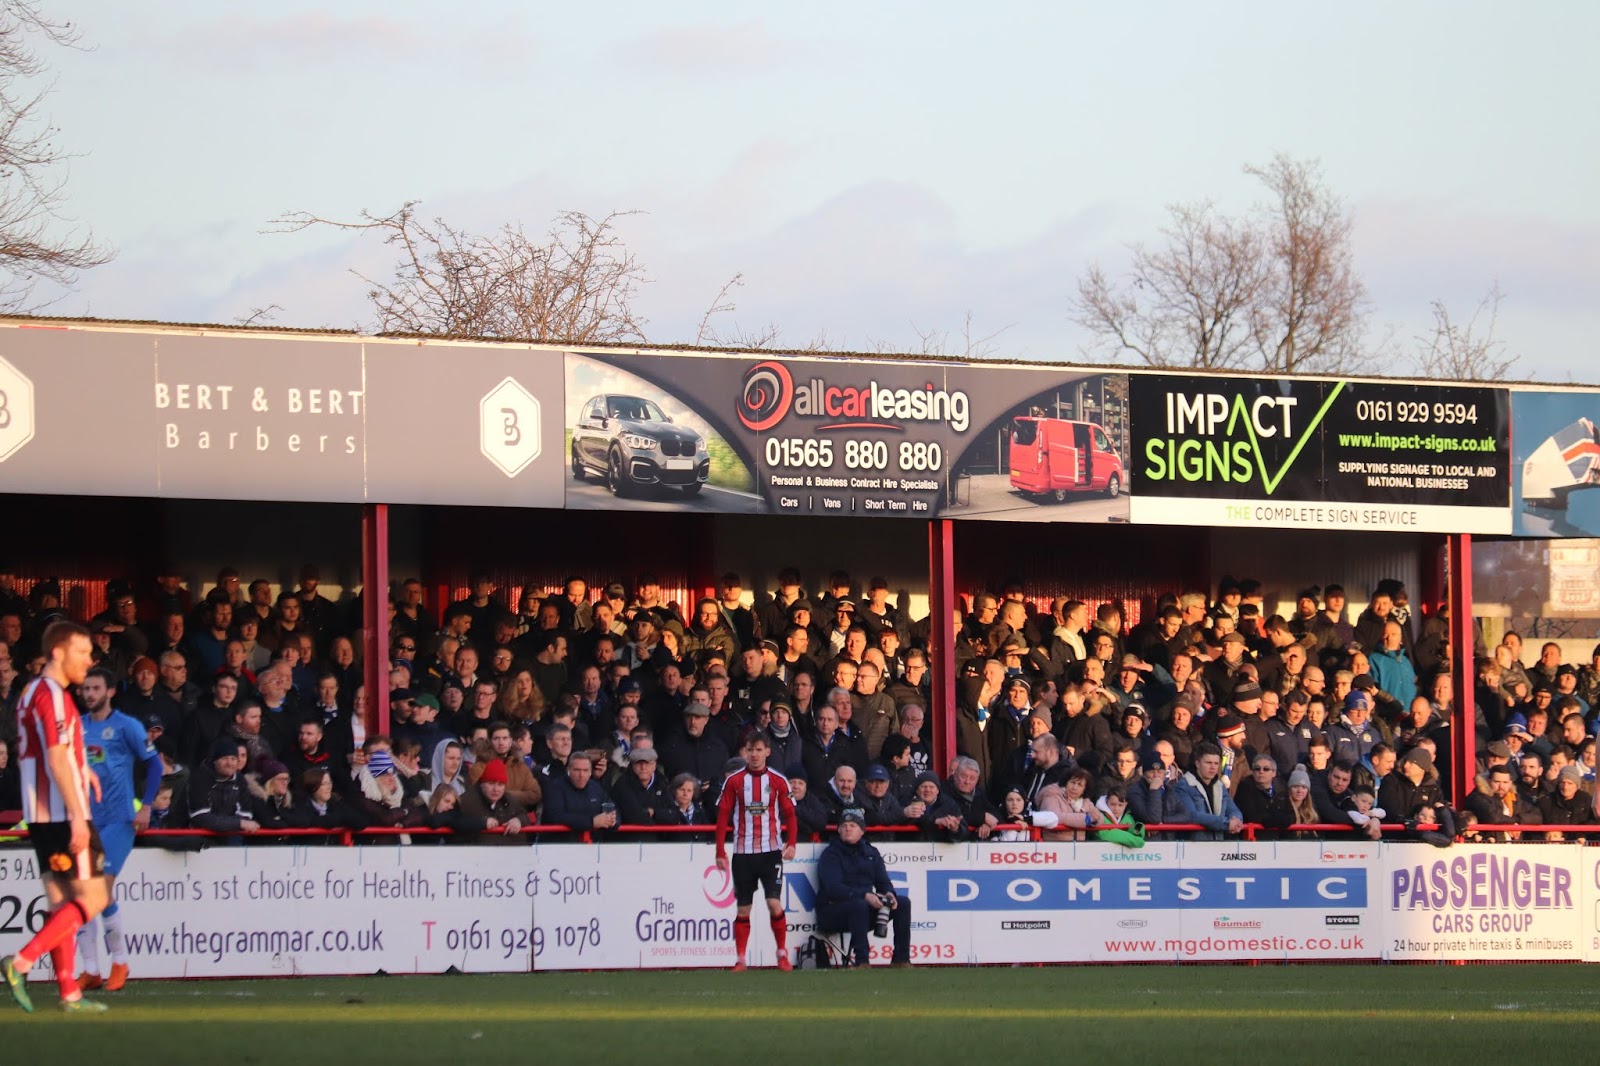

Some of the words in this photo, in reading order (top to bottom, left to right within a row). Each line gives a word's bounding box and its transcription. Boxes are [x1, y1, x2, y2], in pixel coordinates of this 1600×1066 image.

[154, 383, 233, 410] BERT
[251, 387, 269, 412] &
[288, 388, 363, 415] BERT
[794, 378, 970, 432] allcarleasing
[1166, 392, 1298, 438] IMPACT
[1356, 400, 1393, 421] 0161
[1396, 402, 1430, 424] 929
[1433, 403, 1478, 425] 9594
[165, 423, 356, 454] Barbers
[1338, 432, 1497, 453] www.impact-signs.co.uk
[765, 437, 834, 468] 01565
[845, 440, 888, 470] 880
[899, 442, 942, 471] 880
[1145, 438, 1254, 484] SIGNS
[1338, 462, 1389, 474] SUPPLYING
[1389, 464, 1430, 476] SIGNAGE
[1430, 465, 1445, 476] TO
[1445, 466, 1475, 477] LOCAL
[1476, 467, 1497, 477] AND
[771, 475, 803, 486] Personal
[806, 477, 813, 487] &
[815, 477, 848, 488] Business
[850, 477, 881, 489] Contract
[883, 479, 898, 489] Hire
[900, 479, 939, 491] Specialists
[1367, 476, 1415, 488] NATIONAL
[1415, 479, 1469, 490] BUSINESSES
[780, 496, 799, 508] Cars
[823, 498, 842, 508] Vans
[865, 499, 885, 510] Short
[888, 500, 907, 510] Term
[912, 500, 928, 511] Hire
[1226, 506, 1251, 520] THE
[1255, 507, 1324, 522] COMPLETE
[1328, 509, 1359, 523] SIGN
[1363, 510, 1418, 525] SERVICE
[990, 852, 1057, 864] BOSCH
[1101, 853, 1162, 862] SIEMENS
[1221, 853, 1257, 861] ZANUSSI
[775, 865, 783, 879] 7
[1391, 853, 1573, 910] PASSENGER
[114, 872, 202, 901] ncham's
[213, 877, 238, 900] 1st
[249, 870, 314, 900] choice
[325, 869, 354, 898] for
[363, 869, 435, 901] Health,
[446, 870, 515, 898] Fitness
[525, 871, 540, 897] &
[549, 869, 601, 903] Sport
[947, 877, 1348, 903] DOMESTIC
[652, 896, 675, 915] The
[1213, 920, 1261, 928] Baumatic
[1432, 914, 1474, 934] CARS
[1479, 913, 1533, 933] GROUP
[104, 920, 384, 963] ww.thegrammar.co.uk
[422, 921, 437, 950] T
[447, 919, 490, 950] 0161
[501, 927, 545, 958] 929
[555, 917, 601, 955] 1078
[1105, 935, 1364, 955] www.mgdomestic.co.uk
[1393, 939, 1405, 951] 24
[1408, 939, 1430, 951] hour
[1433, 938, 1466, 953] private
[1469, 937, 1487, 950] hire
[1490, 938, 1512, 950] taxis
[1516, 939, 1522, 949] &
[1525, 936, 1573, 950] minibuses
